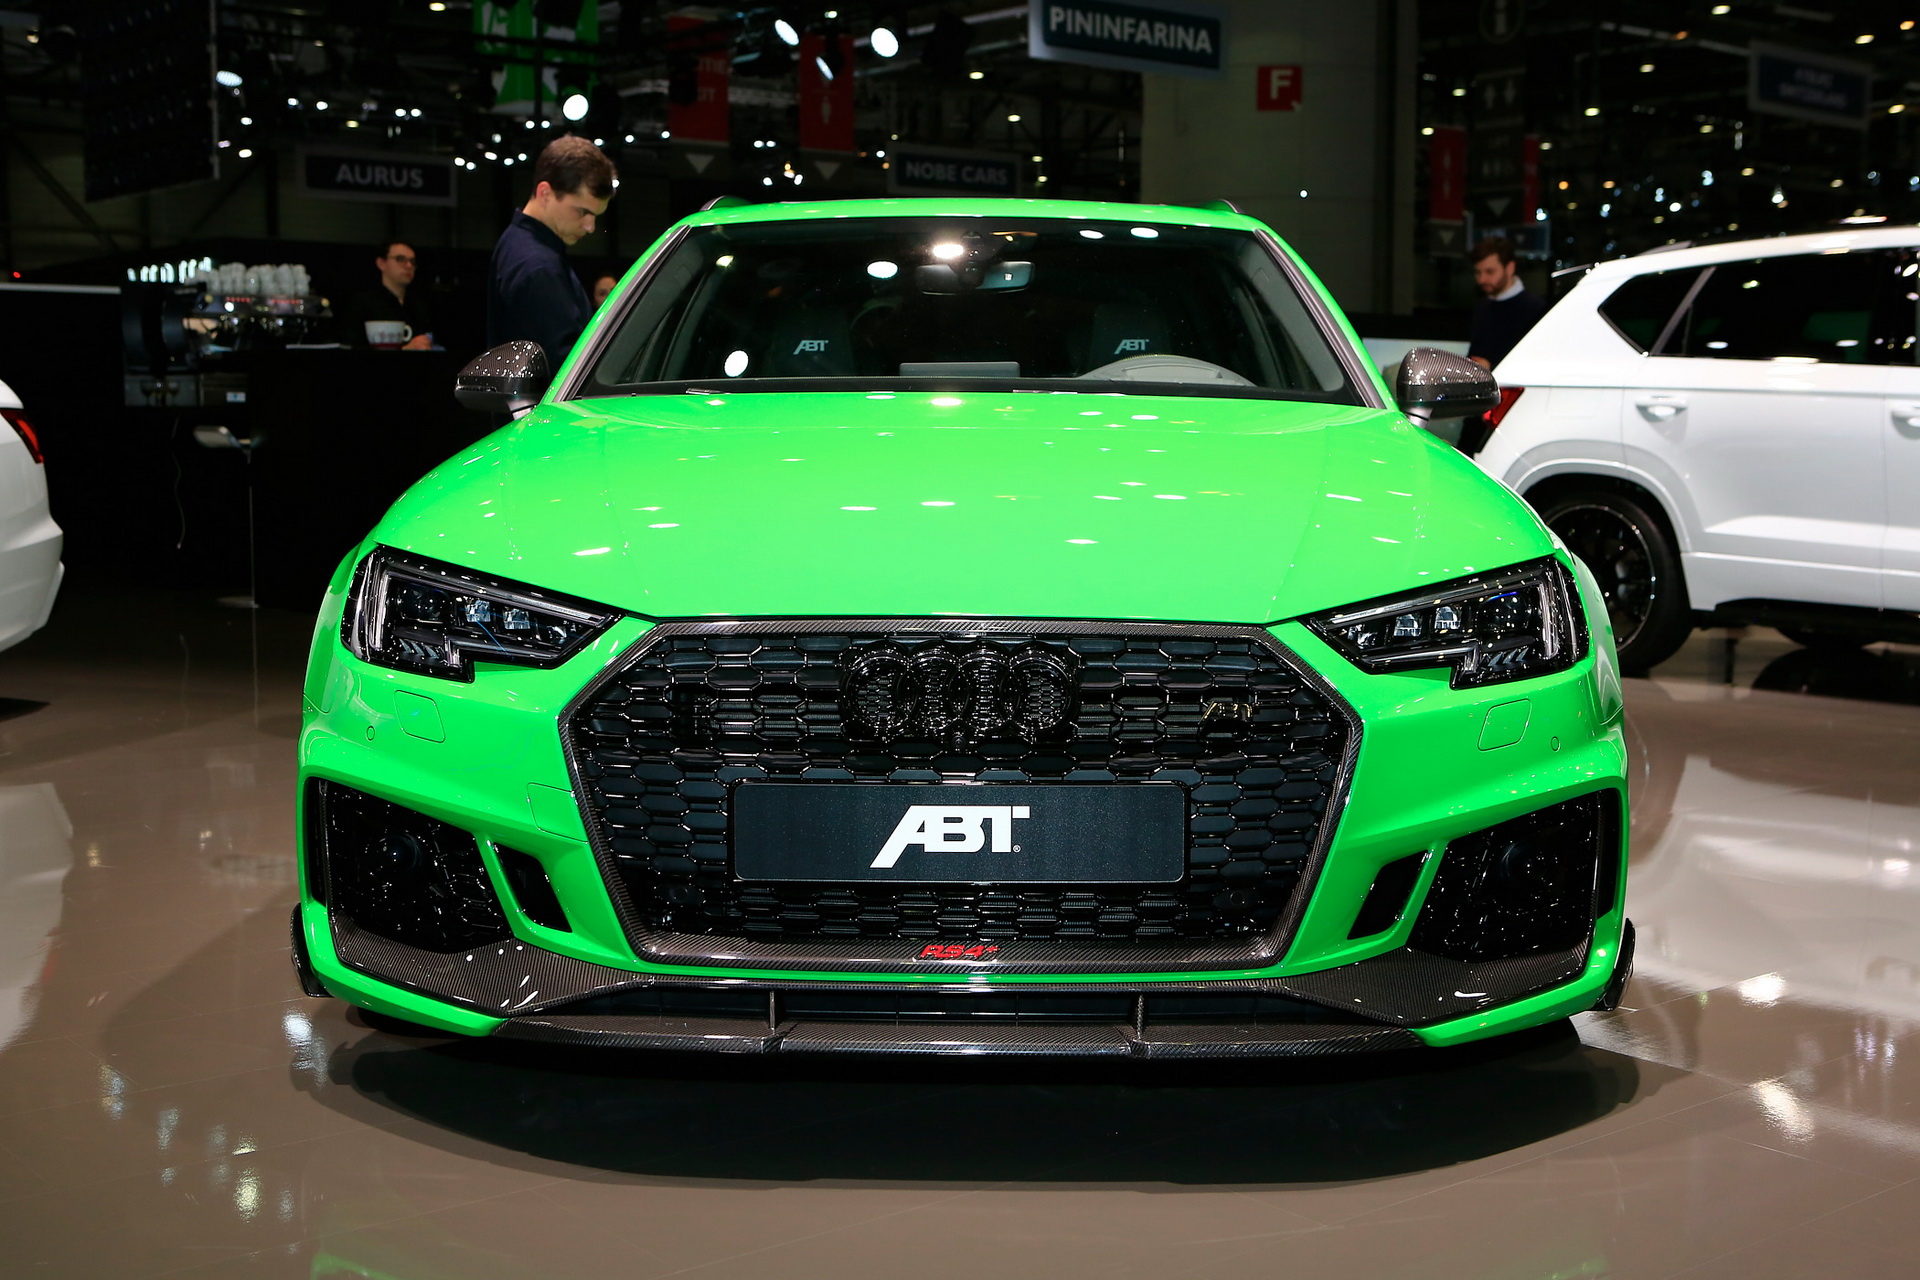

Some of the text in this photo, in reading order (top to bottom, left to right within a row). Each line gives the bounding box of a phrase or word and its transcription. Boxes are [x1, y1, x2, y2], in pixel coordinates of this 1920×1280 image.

[1049, 5, 1214, 55] PININFARINA
[1271, 70, 1294, 100] F
[335, 163, 425, 190] AURUS
[905, 160, 1009, 187] NOBE CARS
[793, 339, 829, 355] ABT
[1113, 338, 1150, 355] ABT
[869, 805, 1031, 868] ABT
